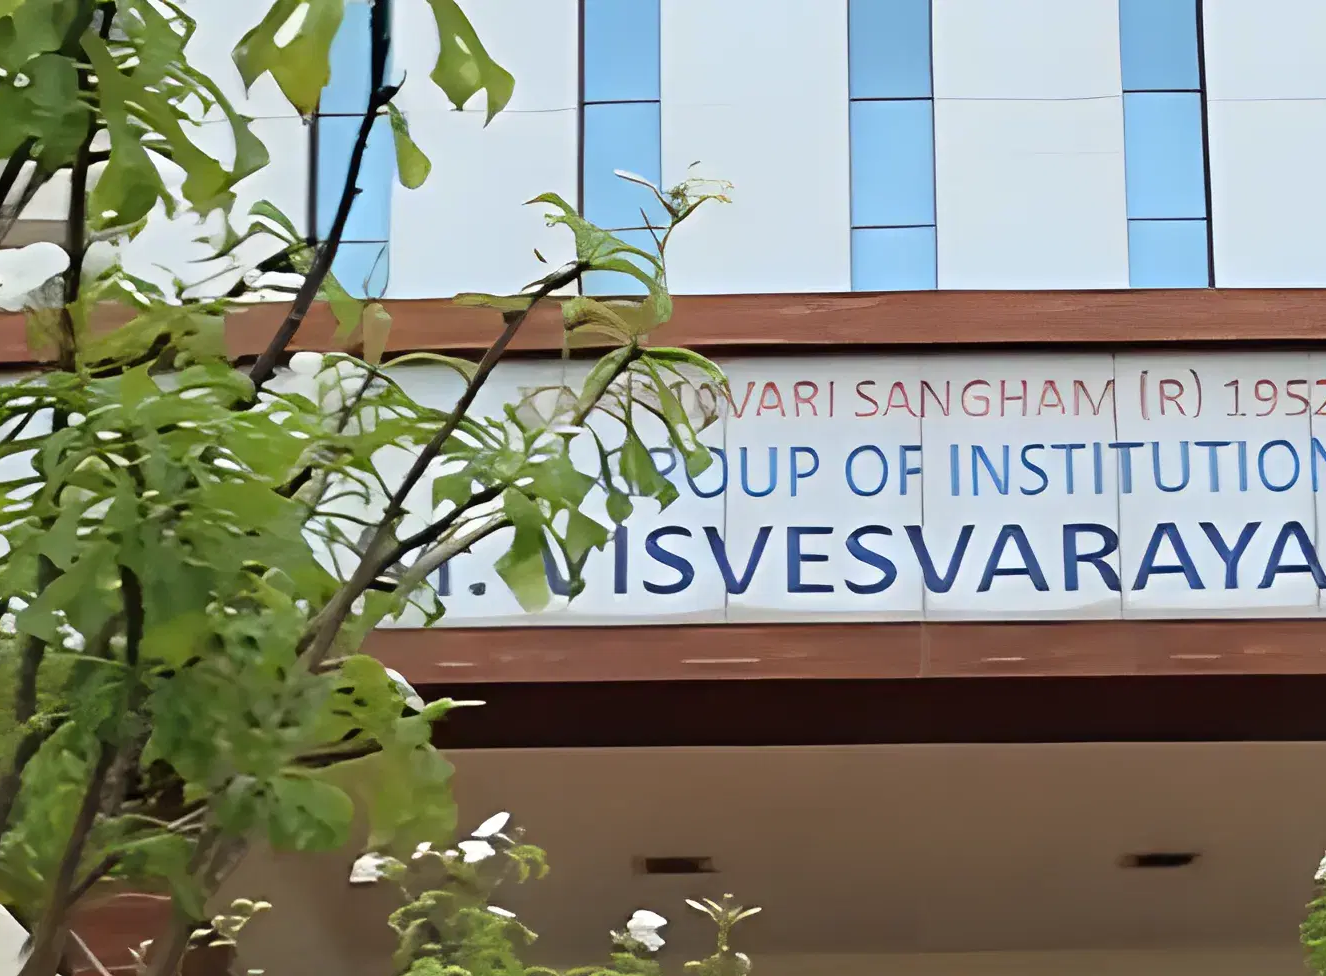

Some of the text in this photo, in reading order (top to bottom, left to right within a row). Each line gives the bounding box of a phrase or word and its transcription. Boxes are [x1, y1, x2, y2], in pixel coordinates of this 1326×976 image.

[852, 379, 1114, 418] SANGHAM
[1139, 369, 1203, 421] (R)
[844, 443, 922, 497] OF
